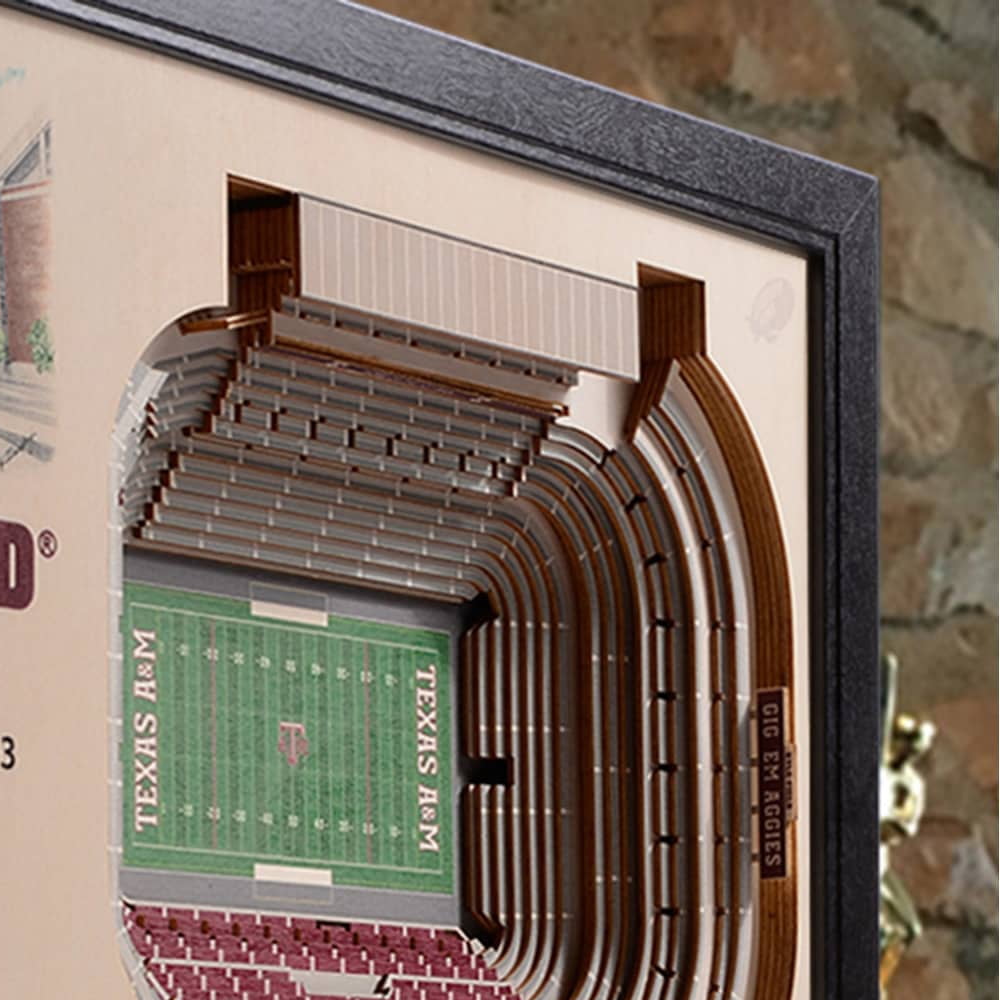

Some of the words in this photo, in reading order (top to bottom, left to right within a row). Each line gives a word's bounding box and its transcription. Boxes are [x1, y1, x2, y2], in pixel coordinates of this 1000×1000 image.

[131, 627, 160, 704] A&M
[414, 664, 439, 776] TEXAS
[762, 703, 780, 738] GIG
[132, 711, 160, 832] TEXAS
[417, 782, 442, 853] A&M
[763, 789, 782, 867] AGGIES
